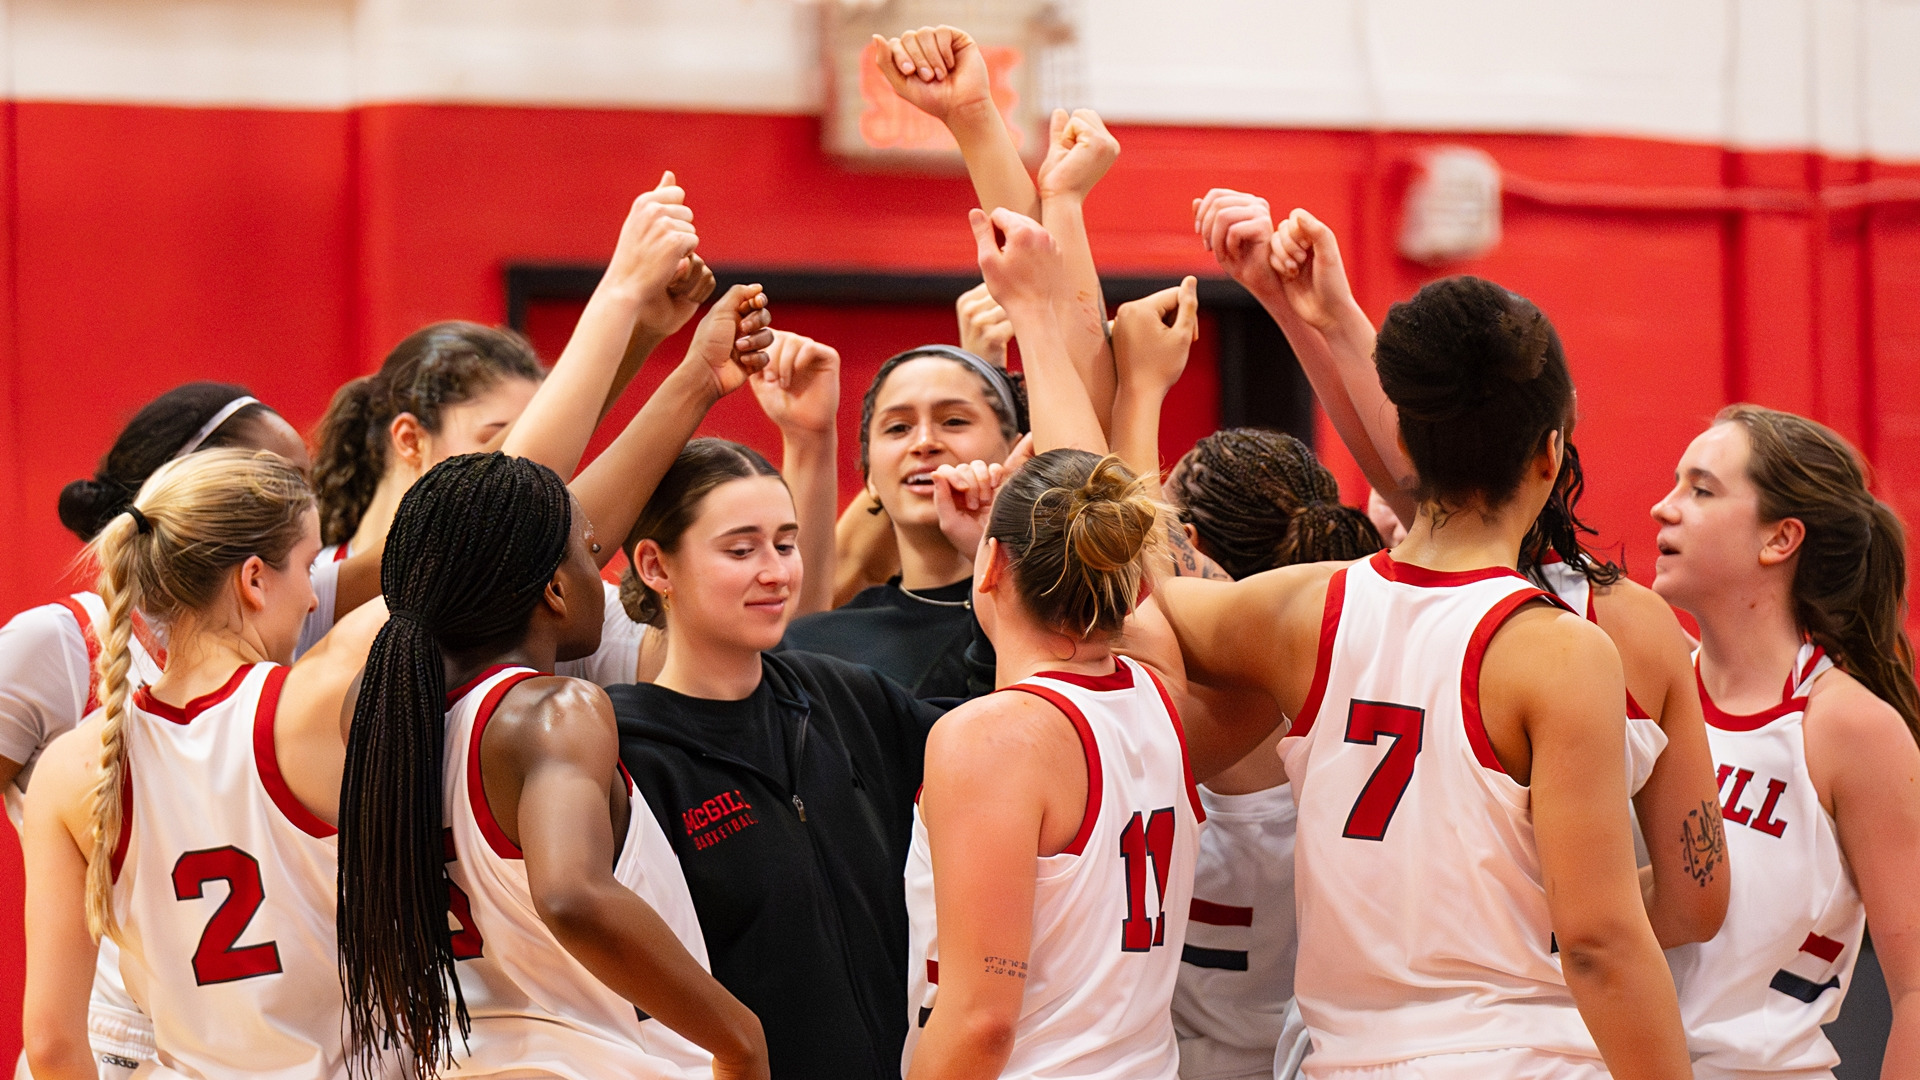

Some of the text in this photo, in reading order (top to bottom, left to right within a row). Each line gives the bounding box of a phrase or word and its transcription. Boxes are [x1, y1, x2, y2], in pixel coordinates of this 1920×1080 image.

[694, 813, 758, 851] BASKETBAL
[1342, 698, 1425, 842] 7
[171, 845, 283, 987] 2
[1119, 806, 1175, 952] 11
